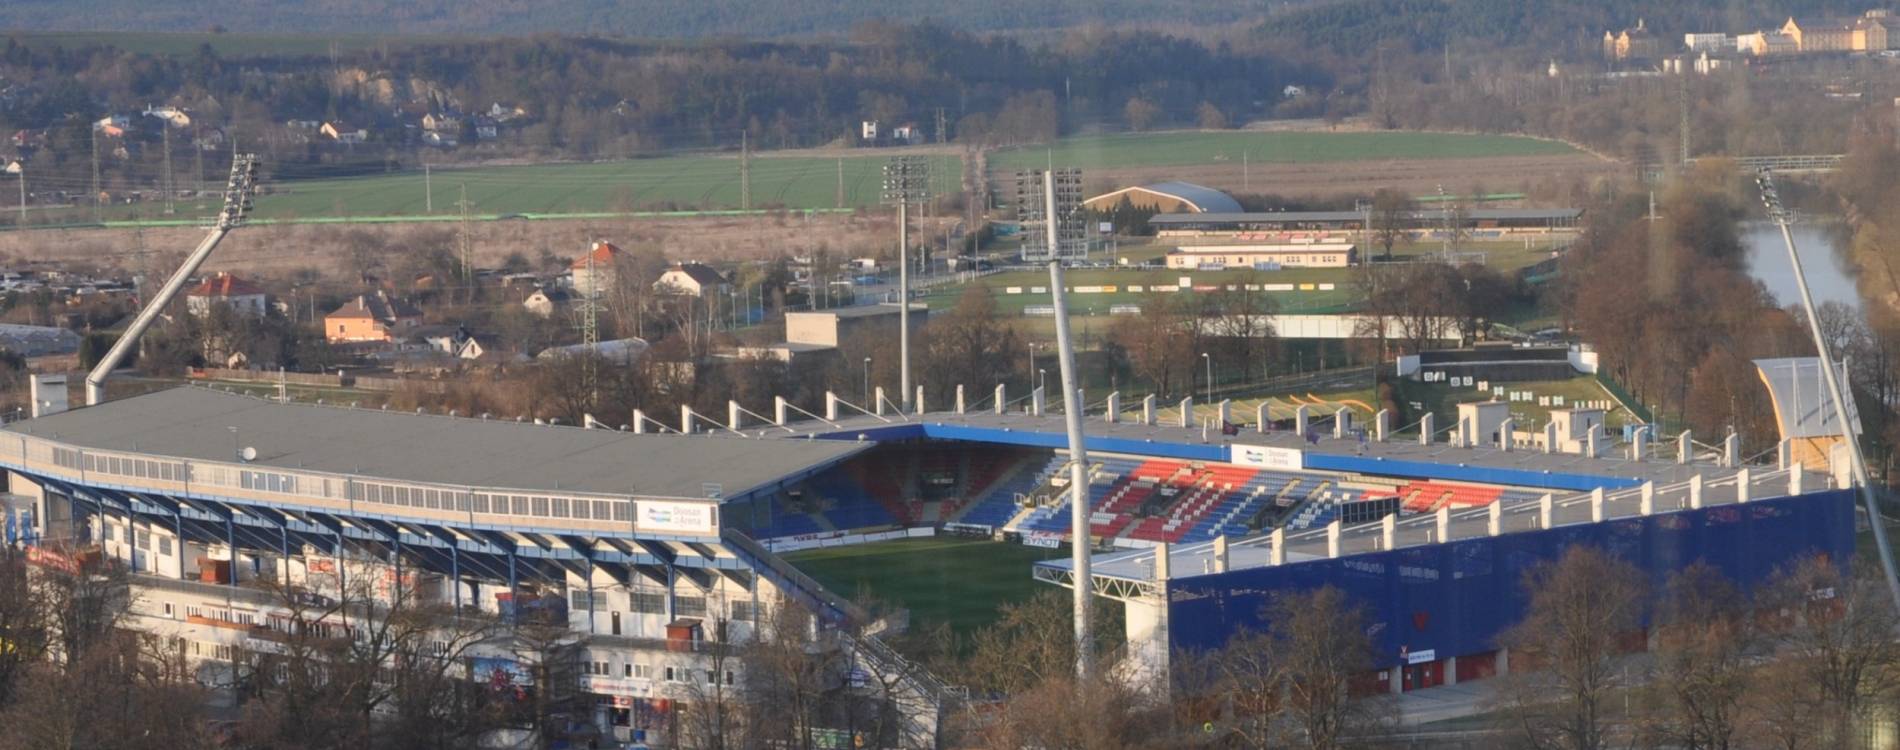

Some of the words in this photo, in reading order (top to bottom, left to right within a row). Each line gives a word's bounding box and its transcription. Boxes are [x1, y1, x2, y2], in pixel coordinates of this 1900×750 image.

[673, 506, 701, 516] Doosan
[680, 516, 701, 525] Arena
[1023, 536, 1058, 547] SYNOT
